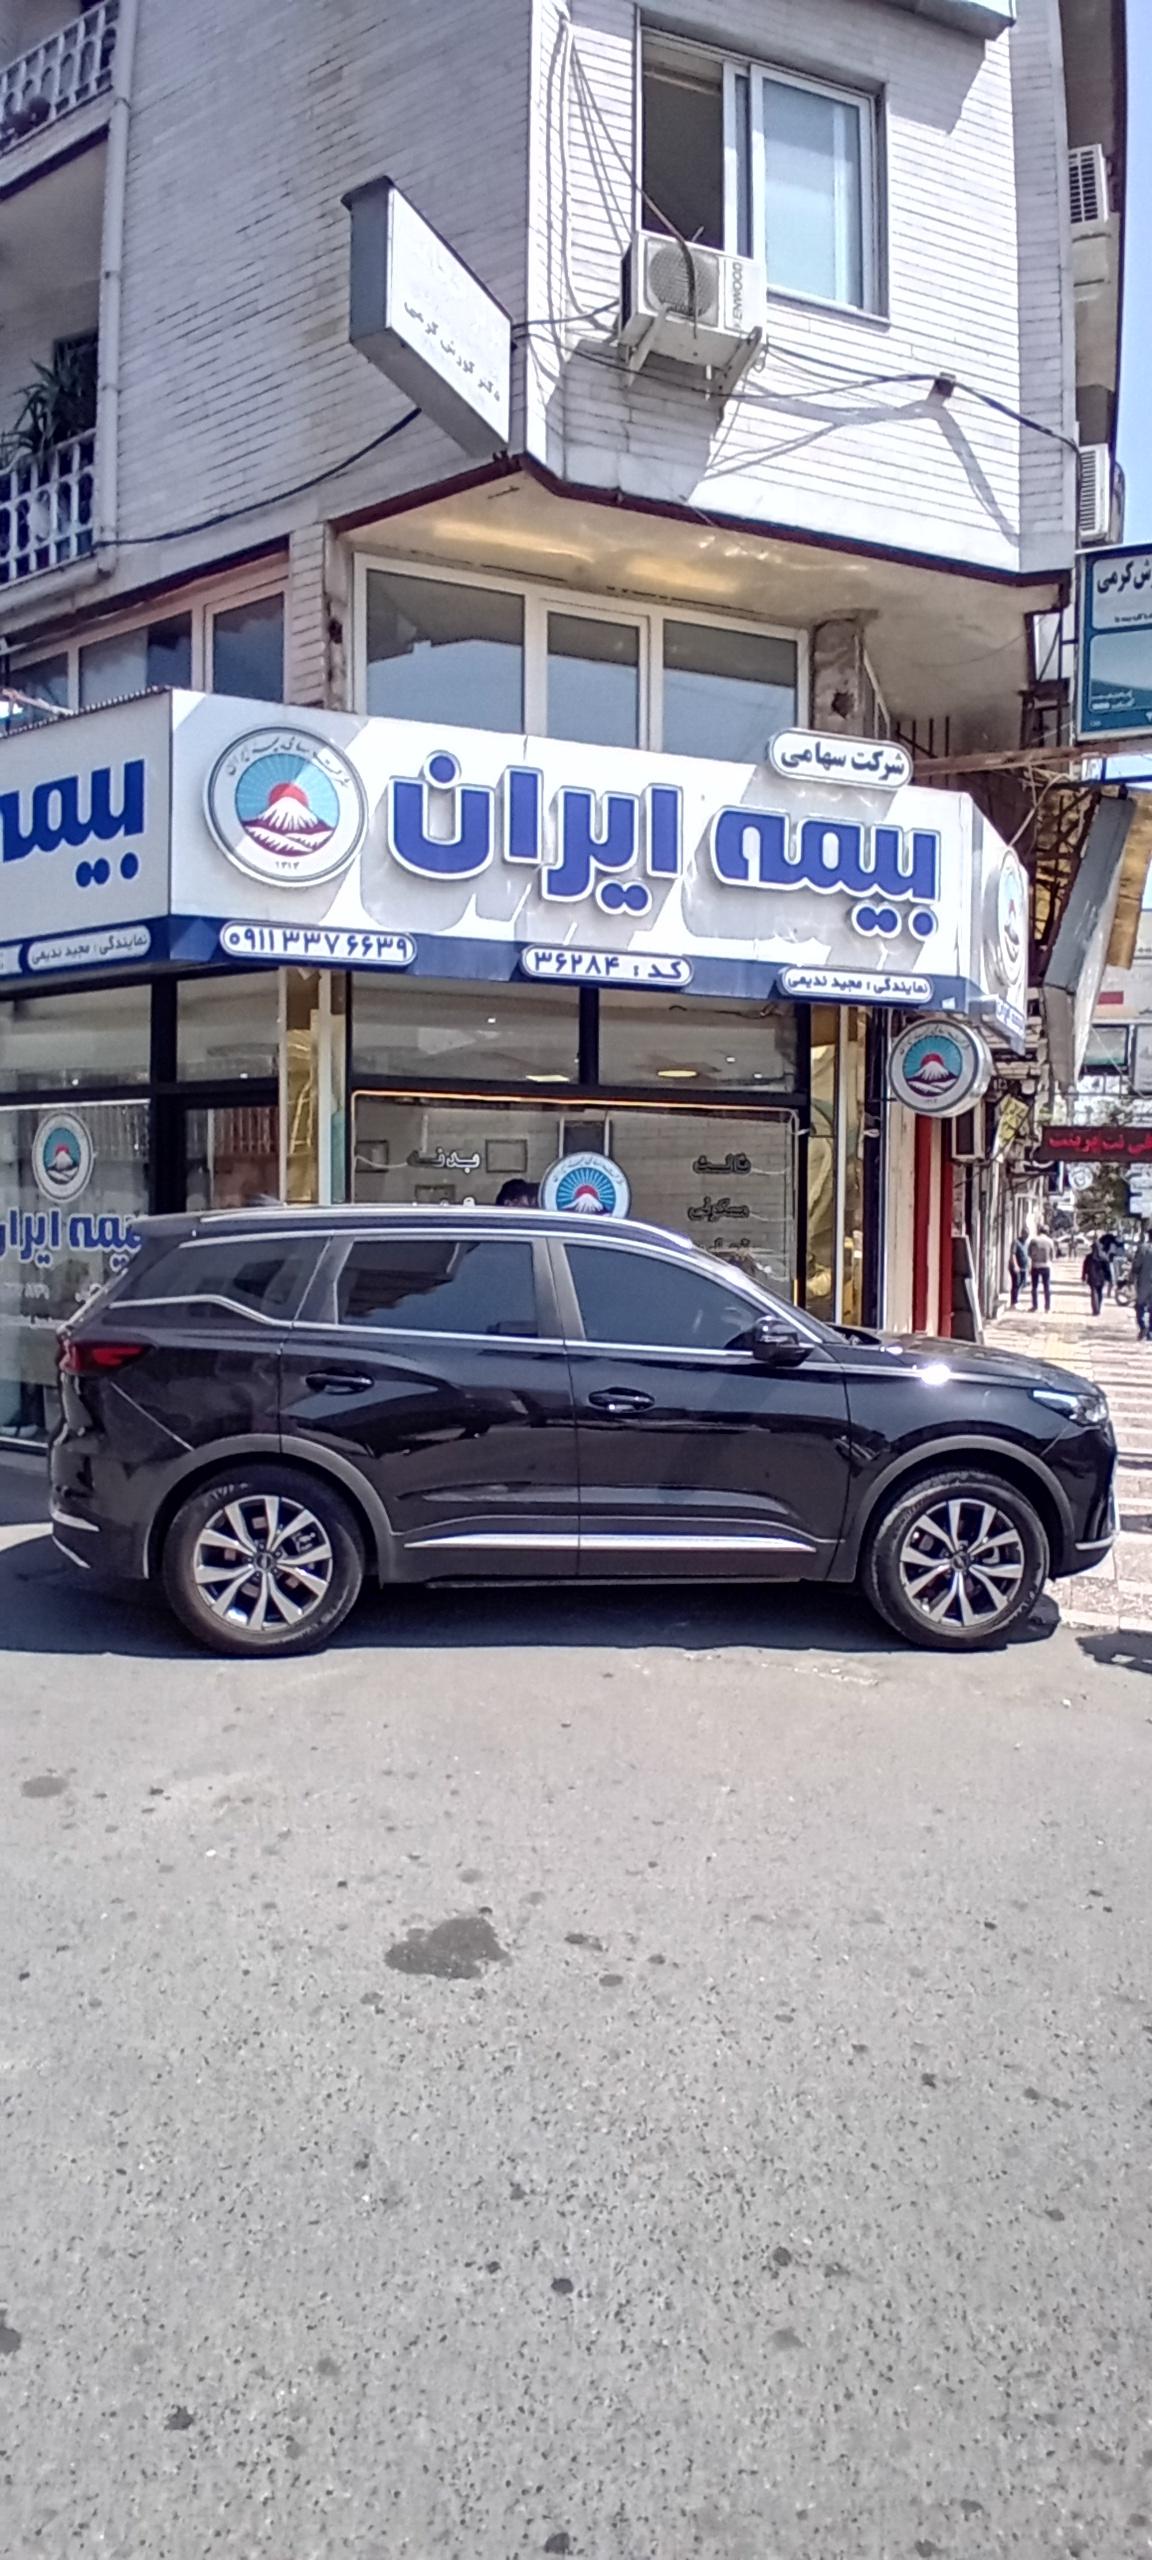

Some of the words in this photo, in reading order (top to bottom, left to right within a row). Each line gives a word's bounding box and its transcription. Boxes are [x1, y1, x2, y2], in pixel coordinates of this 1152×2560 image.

[781, 741, 847, 771] سهامی
[851, 750, 905, 780] شرکت
[391, 751, 682, 914] ایران
[713, 808, 939, 936] بیمه
[534, 951, 620, 976] ۳۶۲۸۴
[788, 975, 827, 988] ندیمی
[831, 977, 862, 992] مجید
[0, 1207, 61, 1268] ایرا
[68, 1212, 141, 1273] یمه
